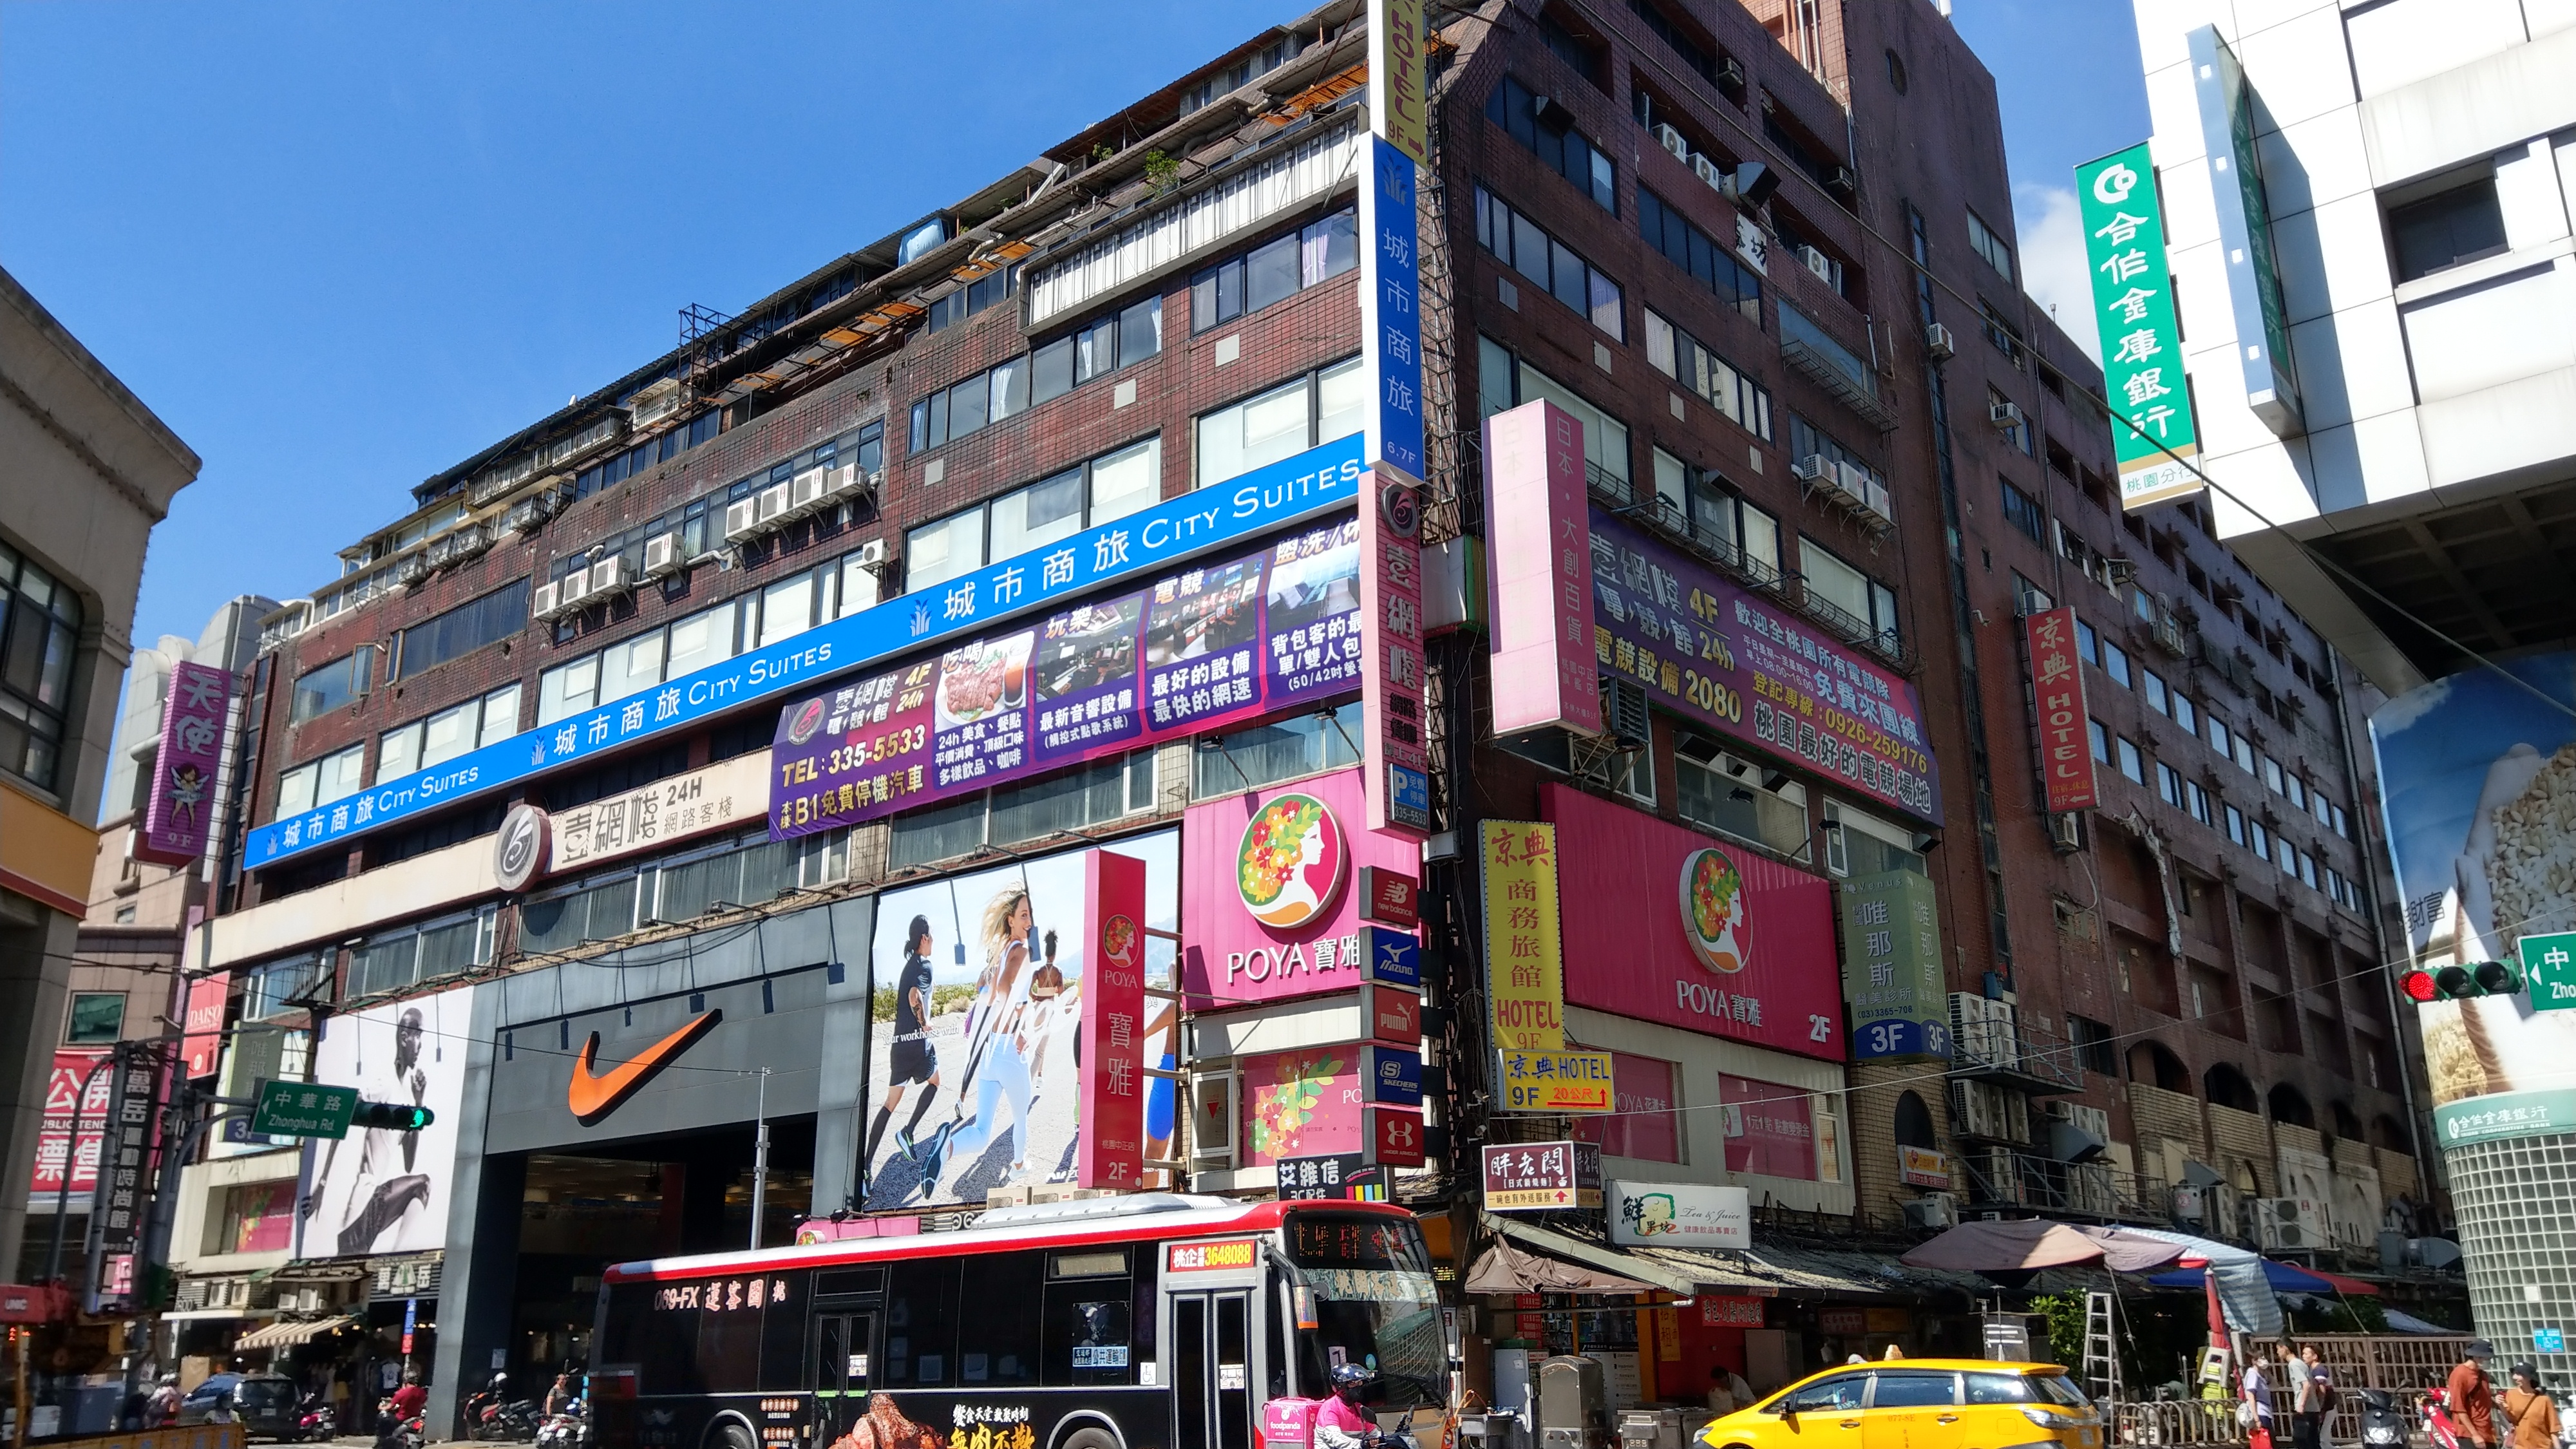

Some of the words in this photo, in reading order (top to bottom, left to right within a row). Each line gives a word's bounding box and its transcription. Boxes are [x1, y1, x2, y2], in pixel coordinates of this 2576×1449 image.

[1390, 4, 1418, 122] HOTEL
[1387, 120, 1405, 144] 9F
[1382, 226, 1414, 417] 城市商旅
[2094, 212, 2175, 440] 合作金庫銀行
[2126, 461, 2193, 493] 桃園分行
[943, 529, 1129, 621] 城市商旅
[1142, 507, 1220, 549] CITY
[1233, 459, 1360, 518] SUITES
[1154, 568, 1204, 604] 電競
[1689, 588, 1719, 624] 4F
[1701, 631, 1734, 672] 24h
[1734, 600, 1891, 701] 歡迎全桃園所有電競隊
[2036, 616, 2072, 686] 京典
[905, 662, 933, 687] 4F
[1151, 650, 1251, 697] 最好的設備
[553, 686, 681, 757] 城市商旅
[688, 674, 741, 705] CITY
[748, 643, 832, 685] SUITES
[896, 690, 924, 713] 24h
[1039, 689, 1132, 732] 最新音響設備
[1153, 678, 1252, 723] 最快的網速
[1685, 669, 1742, 724] 2080
[1814, 669, 1920, 747] 免費來團練
[175, 670, 223, 755] 天使
[938, 735, 959, 749] 24h
[2047, 692, 2079, 778] HOTEL
[1754, 699, 1931, 814] 桃園最好的電競場地
[665, 775, 703, 808] 24H
[1394, 770, 1407, 797] P
[1409, 775, 1425, 791] 免費
[1410, 790, 1425, 805] 停車
[282, 795, 374, 849] 城市商旅
[378, 787, 415, 812] CITY
[420, 766, 479, 800] SUITES
[663, 795, 734, 835] 網路客棧
[1394, 806, 1427, 824] 335-5533
[2054, 795, 2068, 806] 9F
[1491, 828, 1551, 867] 京典
[1859, 877, 1902, 890] Venus
[1390, 904, 1412, 917] balance
[1507, 878, 1542, 989] 商務旅館
[1864, 900, 1894, 988] 唯那斯
[1227, 942, 1309, 983] POYA
[1313, 934, 1359, 971] 寶雅
[2544, 947, 2570, 971] 中
[1104, 970, 1139, 989] POYA
[1676, 980, 1730, 1020] POYA
[1731, 994, 1763, 1028] 寶雅
[1855, 988, 1912, 1006] 醫美診所
[190, 1004, 222, 1027] DAISO
[1497, 999, 1560, 1029] HOTEL
[1809, 1014, 1831, 1043] 2F
[882, 1032, 899, 1045] Your
[900, 1028, 940, 1043] workhorse
[941, 1023, 960, 1037] with
[1871, 1024, 1904, 1052] 3F
[1929, 1025, 1943, 1052] 3F
[1107, 1011, 1133, 1097] 寶雅
[1508, 1054, 1556, 1080] 京典
[1558, 1057, 1611, 1080] HOTEL
[1383, 1078, 1418, 1089] SKECHERS
[1513, 1086, 1540, 1106] 9F
[1553, 1087, 1593, 1100] 20公尺
[275, 1090, 341, 1112] 中華路
[269, 1114, 317, 1131] Zhonghua
[2459, 1106, 2547, 1129] 合作金庫銀行
[1101, 1139, 1135, 1152] 桃園中正店
[1108, 1161, 1128, 1180] 2F
[1279, 1158, 1340, 1188] 艾維信
[1492, 1147, 1564, 1177] 胖老闆
[1622, 1197, 1644, 1229] 鮮
[1680, 1207, 1704, 1220] Tea
[1713, 1209, 1741, 1224] Juice
[1684, 1226, 1738, 1236] 健康飲品專賣店
[1205, 1244, 1251, 1266] 3648088
